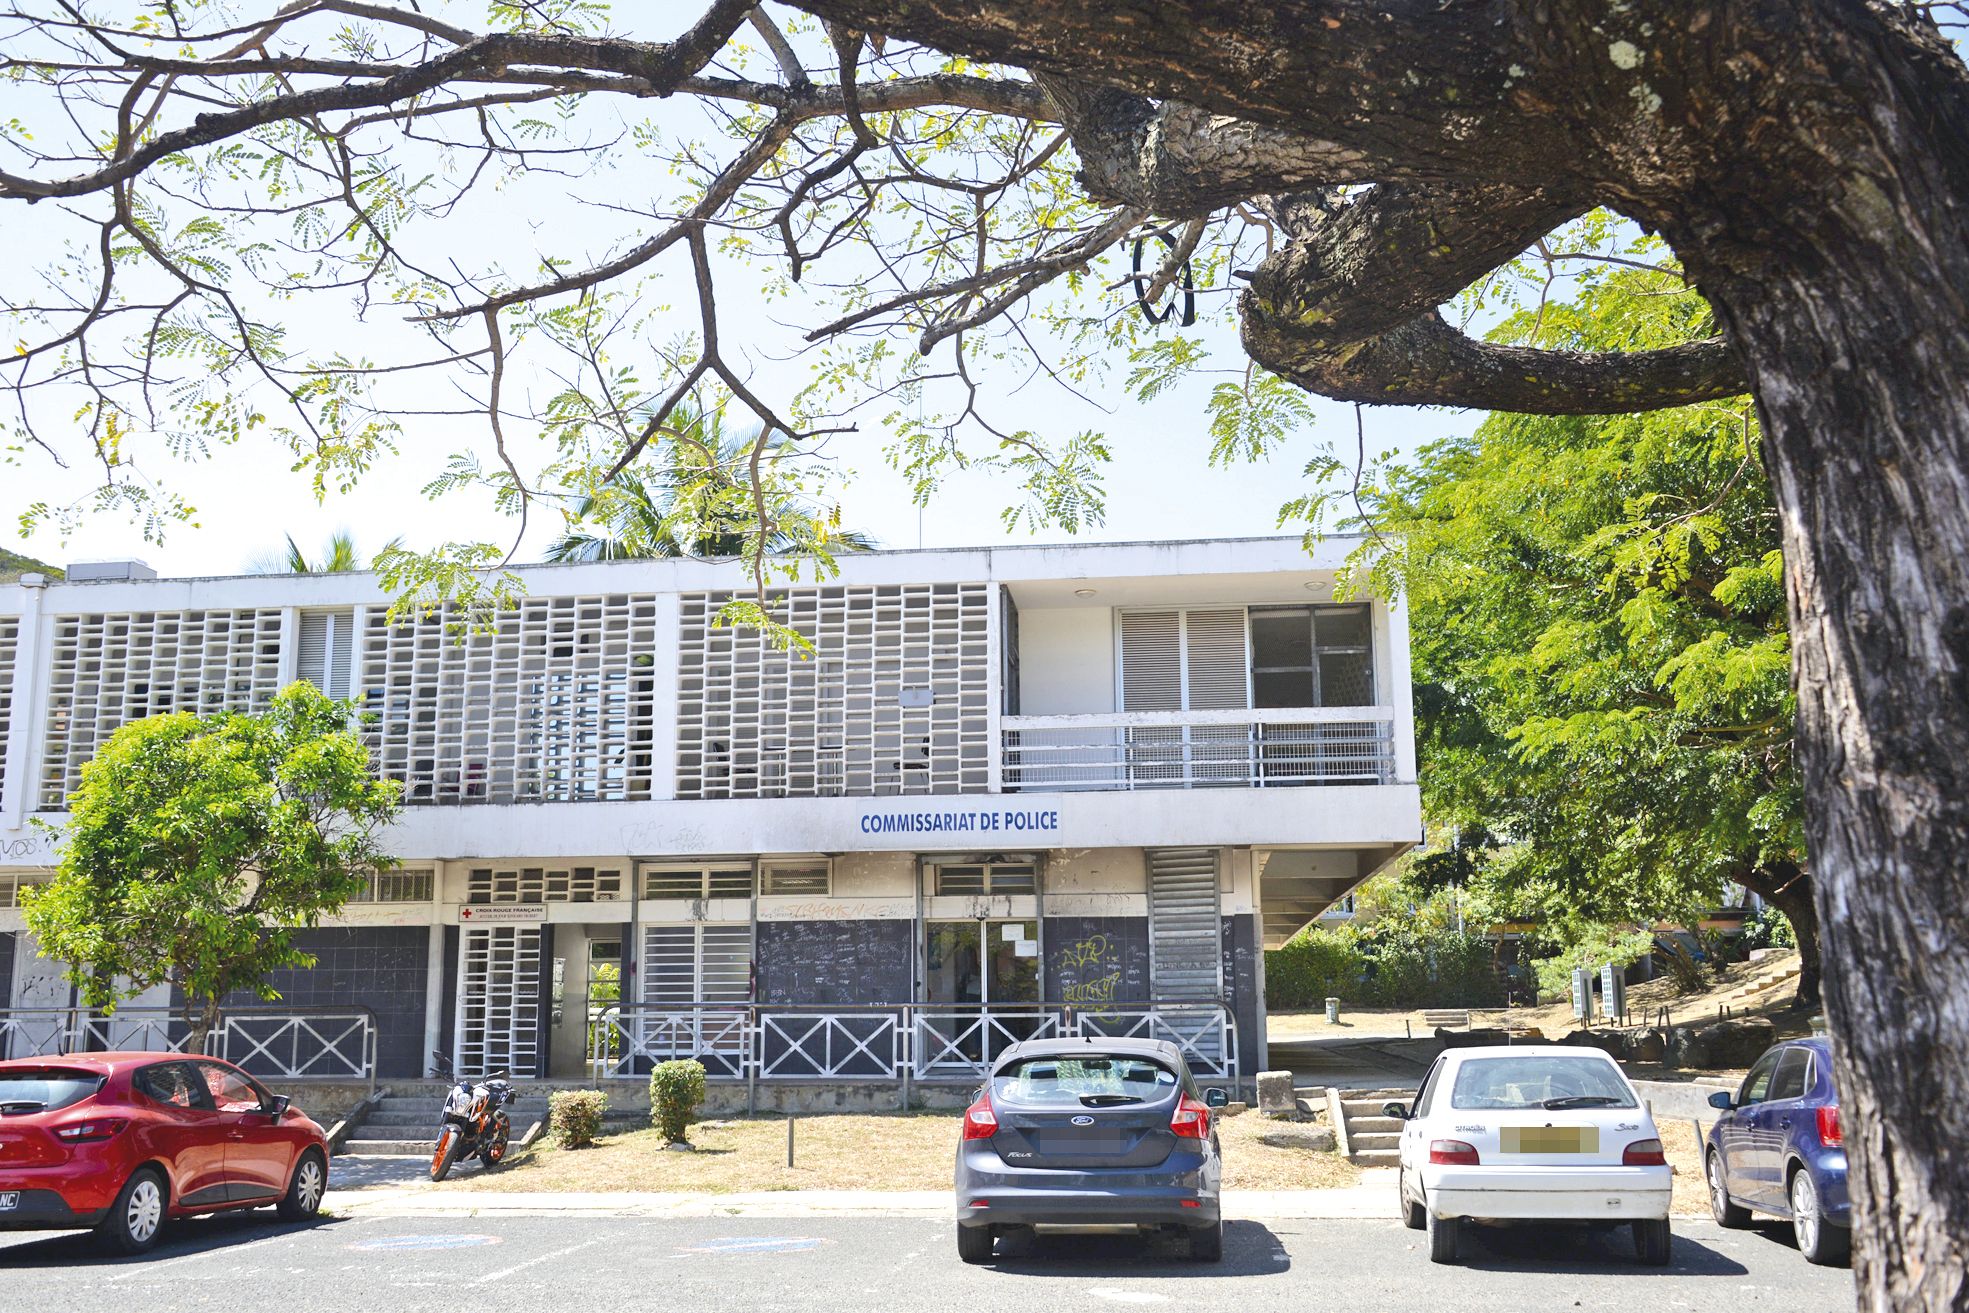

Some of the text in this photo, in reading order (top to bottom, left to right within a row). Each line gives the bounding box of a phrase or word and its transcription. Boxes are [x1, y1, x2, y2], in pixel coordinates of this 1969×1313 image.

[861, 811, 1058, 833] COMMISSARIAT DE POLICE
